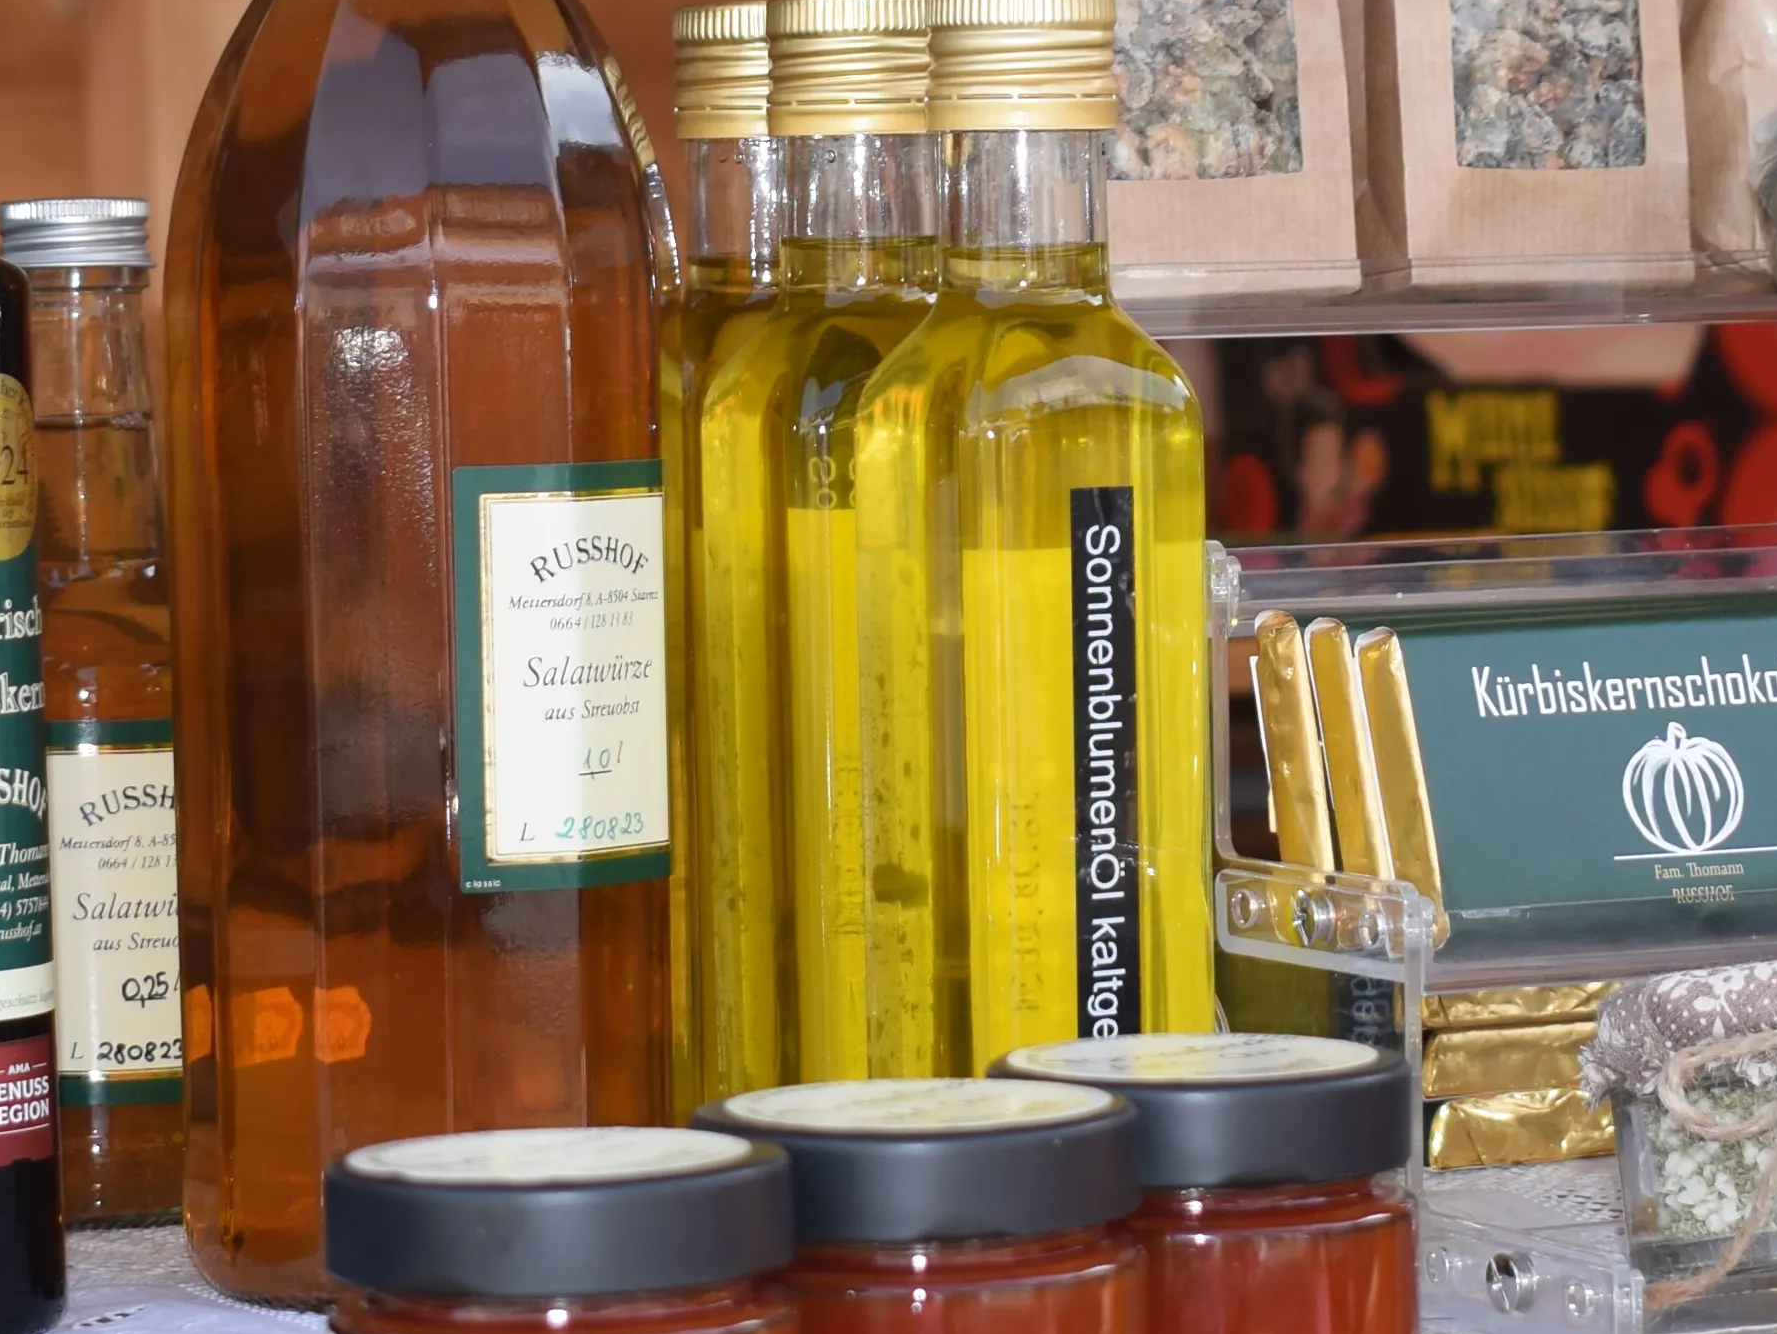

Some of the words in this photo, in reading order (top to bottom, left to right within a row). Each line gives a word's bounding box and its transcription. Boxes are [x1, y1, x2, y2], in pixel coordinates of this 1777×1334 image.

[529, 535, 650, 584] RUSSHOF
[508, 593, 584, 612] Mettersdorf
[595, 588, 630, 605] A-8504
[550, 615, 582, 632] 0664
[590, 613, 608, 630] 128
[622, 611, 634, 627] 83
[523, 653, 654, 689] Salatwürze
[544, 706, 575, 723] aus
[581, 696, 640, 722] Streuobst
[1084, 522, 1126, 902] SonnenblumenÖl
[79, 783, 175, 827] RUSSH
[519, 822, 536, 842] L
[555, 811, 645, 841] 280823
[59, 834, 130, 852] Mettersdorf
[97, 854, 127, 871] 0664
[141, 854, 161, 869] 128
[1654, 863, 1685, 880] Fam.
[1686, 861, 1745, 878] Thomann
[465, 878, 502, 888] classic
[1672, 884, 1736, 905] RUSSHOF
[92, 938, 122, 952] aus
[1086, 913, 1126, 1040] kaltge
[122, 971, 169, 1008] 0,25
[70, 1041, 84, 1060] L
[97, 1037, 183, 1065] 280823
[8, 1062, 31, 1075] AMA
